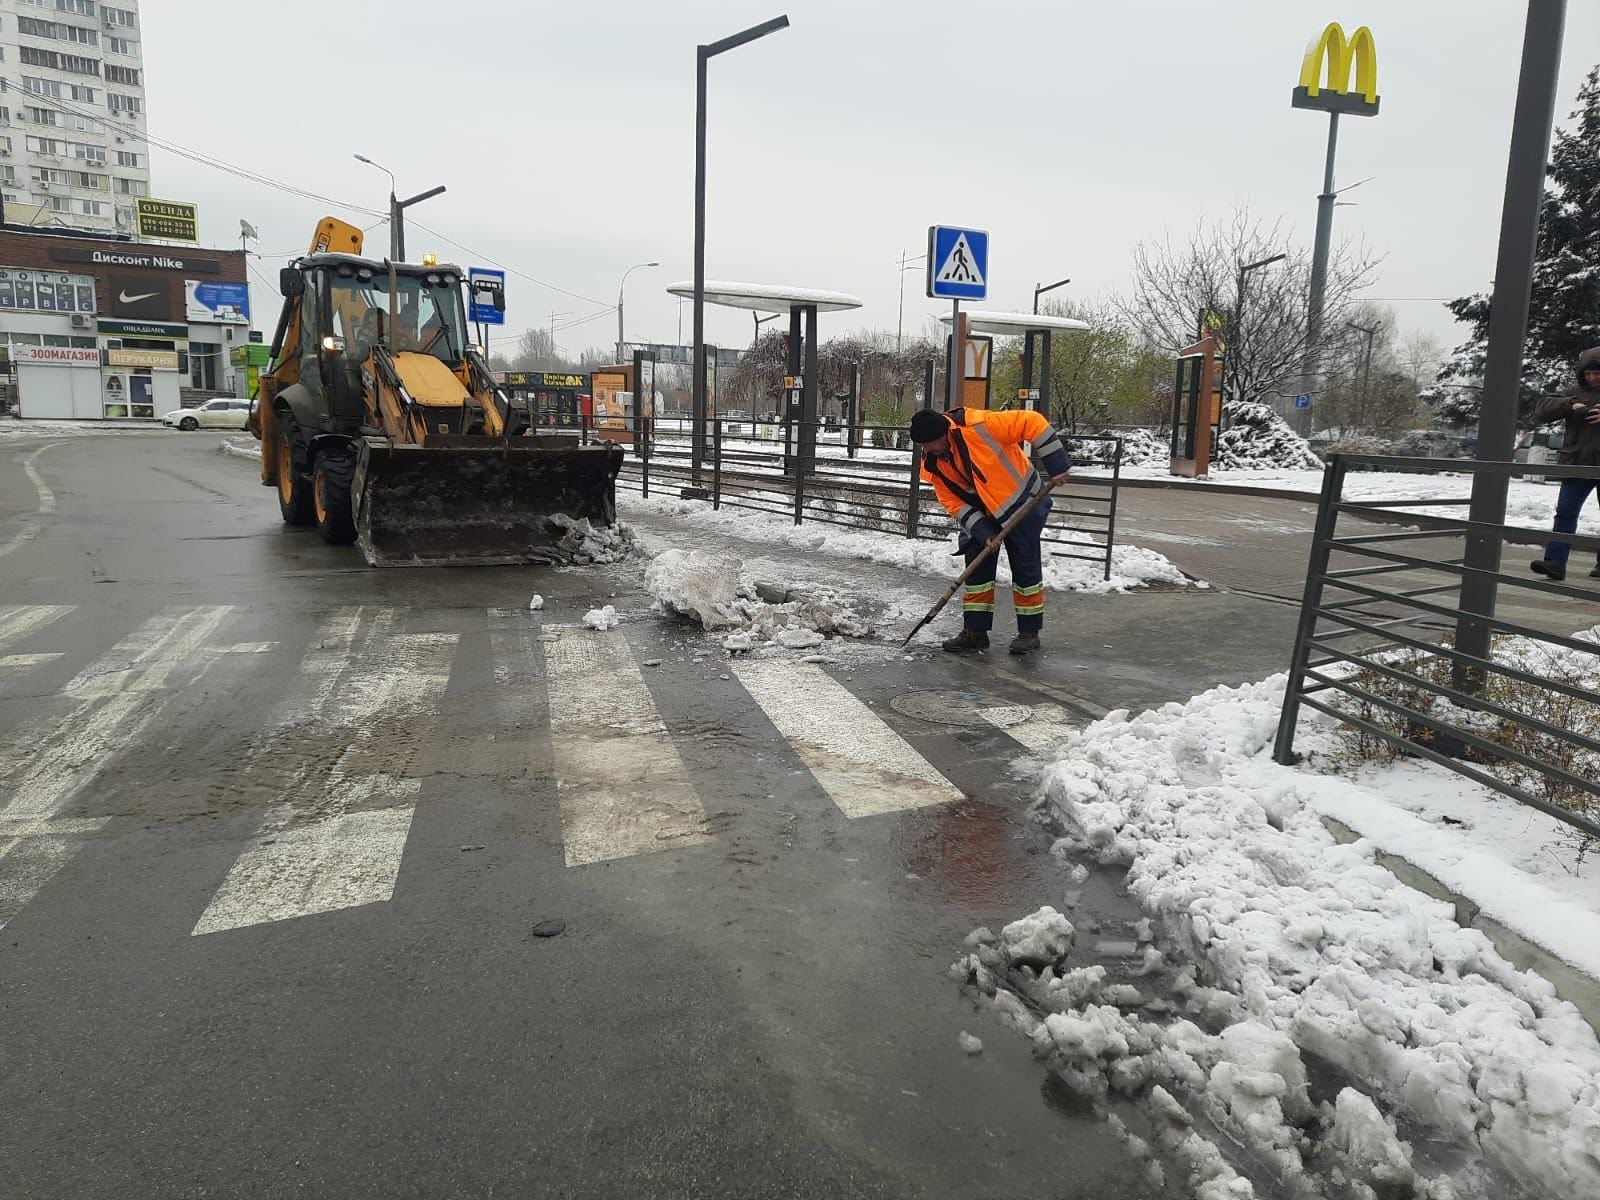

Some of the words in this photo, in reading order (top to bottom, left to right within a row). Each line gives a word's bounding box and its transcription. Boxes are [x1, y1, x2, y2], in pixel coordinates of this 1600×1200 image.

[143, 203, 192, 217] ОРЕНДА
[92, 251, 150, 266] Дисконт
[153, 256, 183, 269] Nike
[31, 348, 98, 361] ЗООМАГАЗИН
